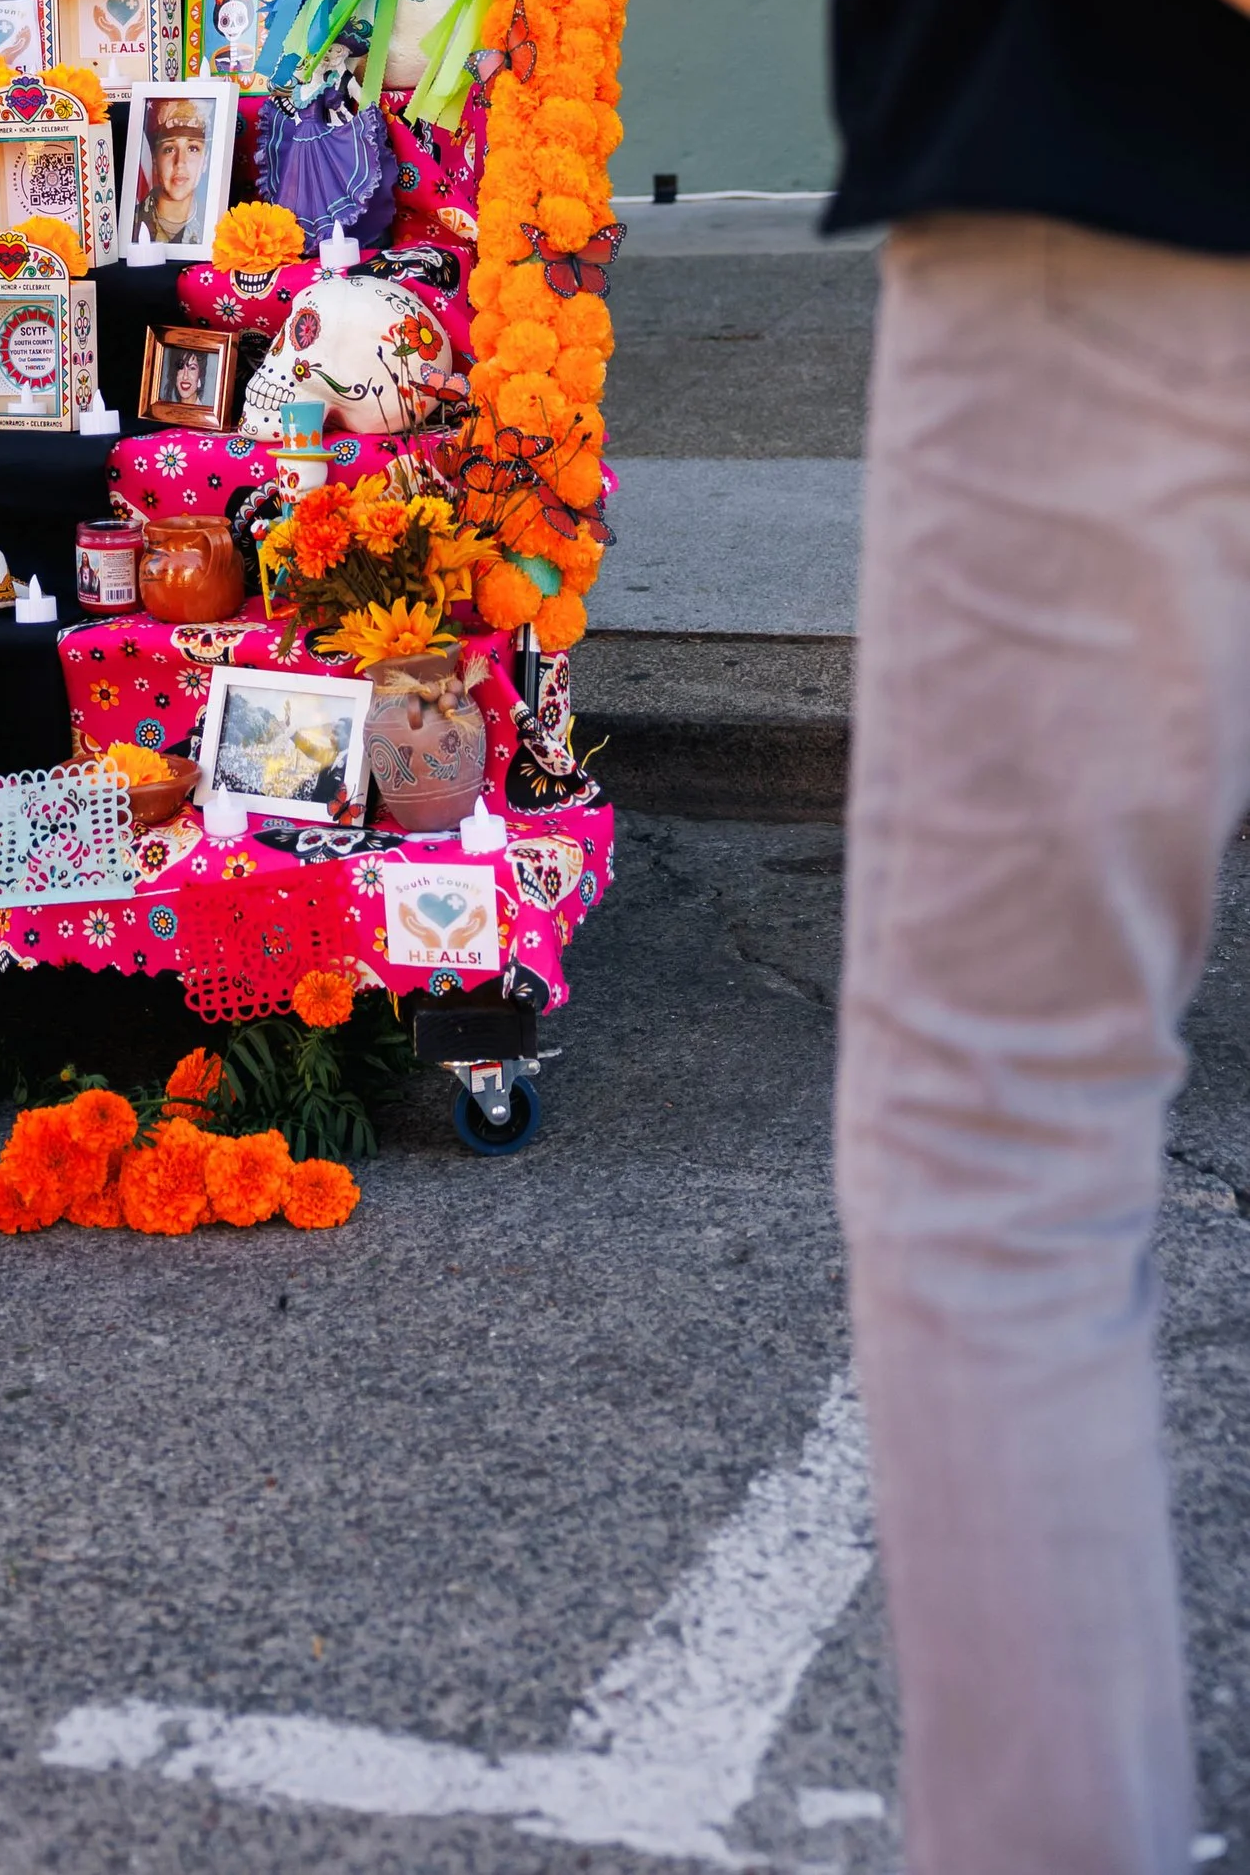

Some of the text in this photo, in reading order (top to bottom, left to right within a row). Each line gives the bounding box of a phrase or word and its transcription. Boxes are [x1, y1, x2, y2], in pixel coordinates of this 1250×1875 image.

[99, 43, 145, 53] H.E.A.L.S
[20, 327, 47, 336] SCYTF
[395, 876, 482, 895] South County
[409, 950, 482, 964] H.E.A.L.S!
